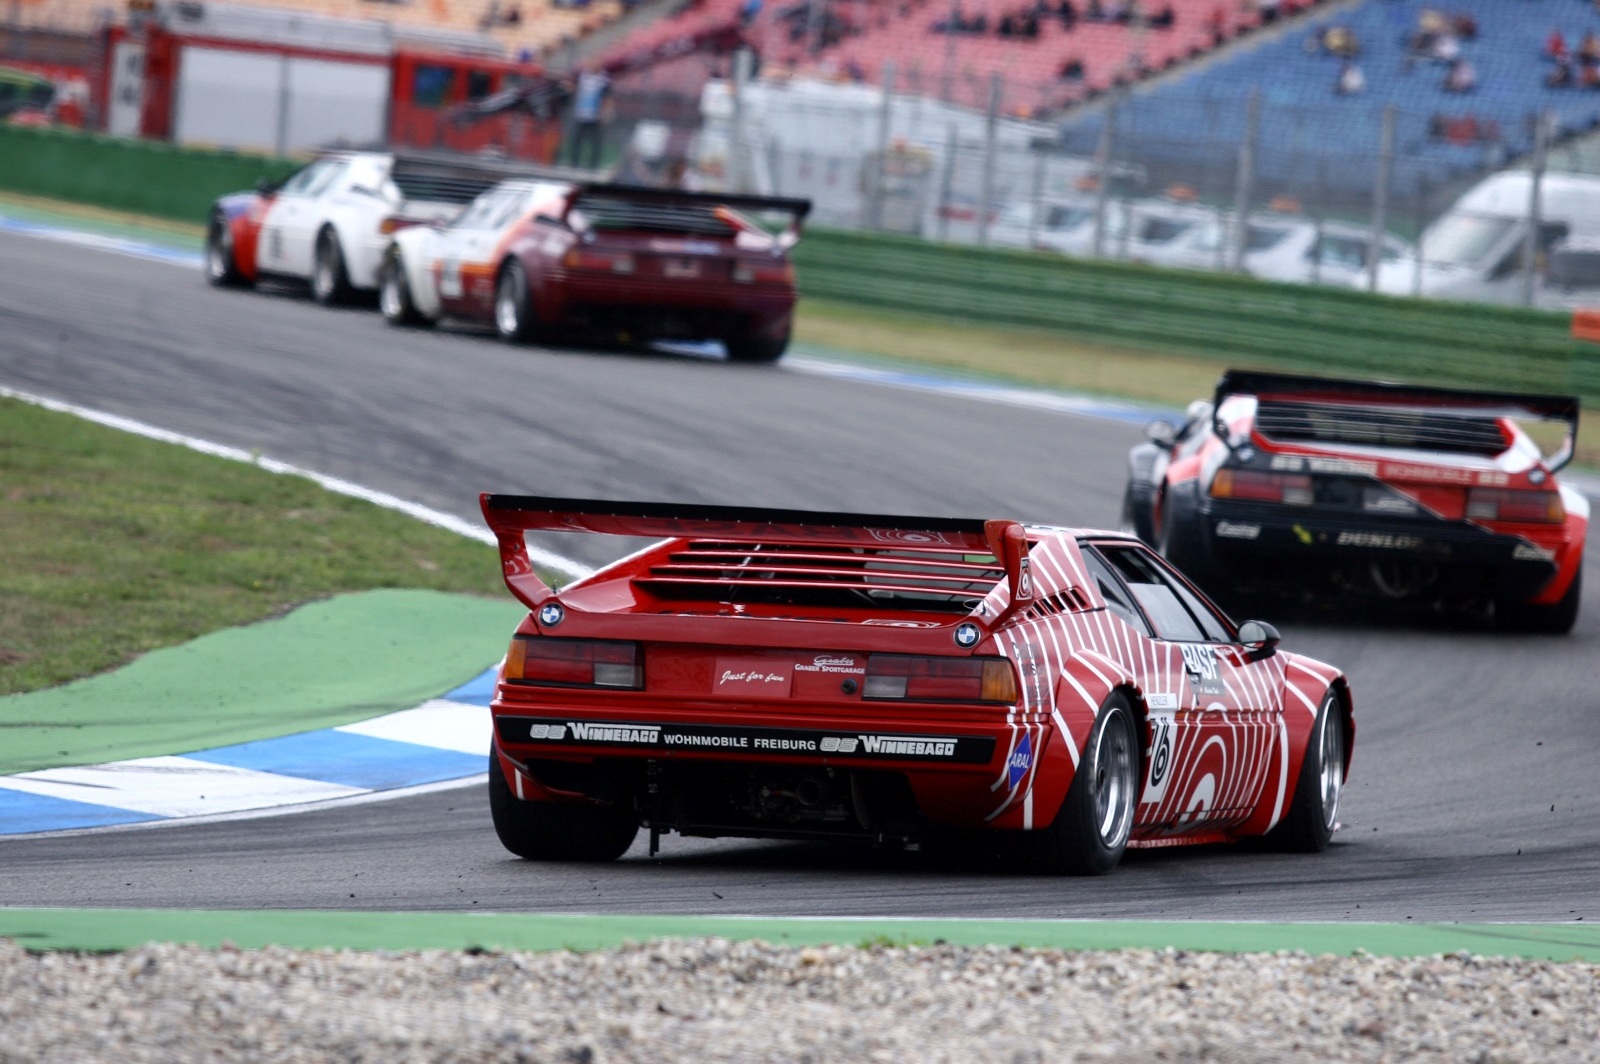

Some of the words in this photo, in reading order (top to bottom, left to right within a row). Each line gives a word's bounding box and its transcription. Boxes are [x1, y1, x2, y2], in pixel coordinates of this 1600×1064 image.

[720, 670, 746, 685] Just
[746, 671, 763, 682] for
[765, 673, 784, 682] fun
[664, 734, 748, 747] WOHNMOBILE
[754, 738, 816, 750] FREIBURG
[1009, 752, 1030, 769] ARAL
